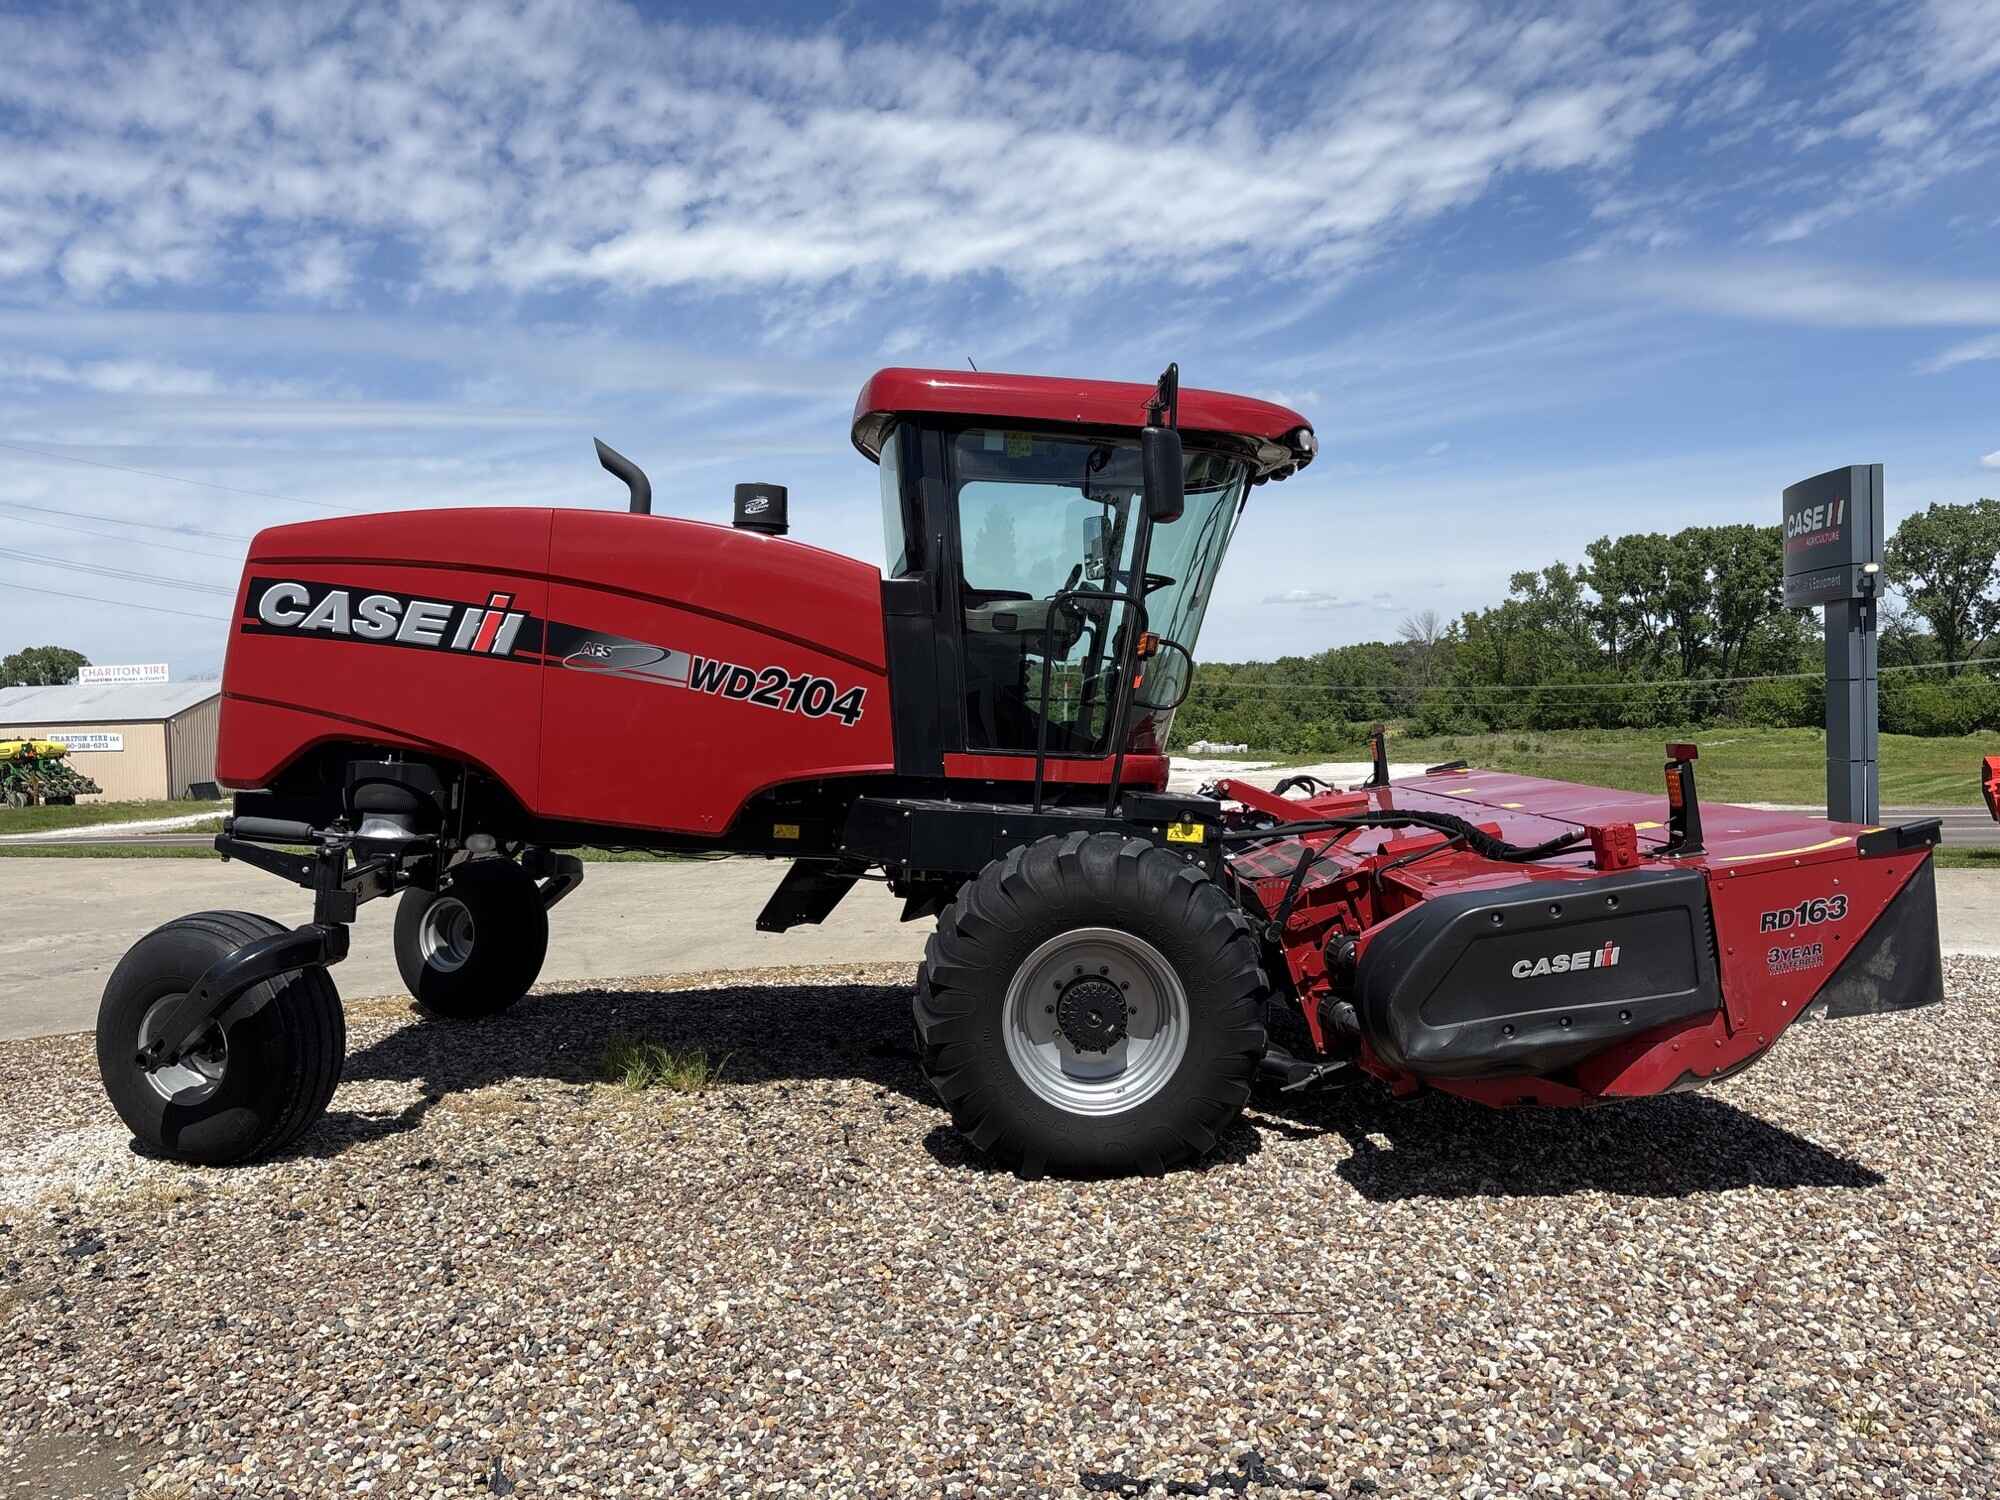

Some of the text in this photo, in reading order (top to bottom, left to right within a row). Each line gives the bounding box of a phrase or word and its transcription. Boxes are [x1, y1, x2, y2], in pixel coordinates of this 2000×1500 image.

[1787, 504, 1824, 538] CASE
[258, 582, 453, 646] CASE
[580, 641, 613, 659] AFS
[81, 665, 166, 677] CHARITON TIRE
[688, 655, 868, 727] WD2104
[1760, 894, 1848, 933] RD163
[1511, 951, 1591, 978] CASE
